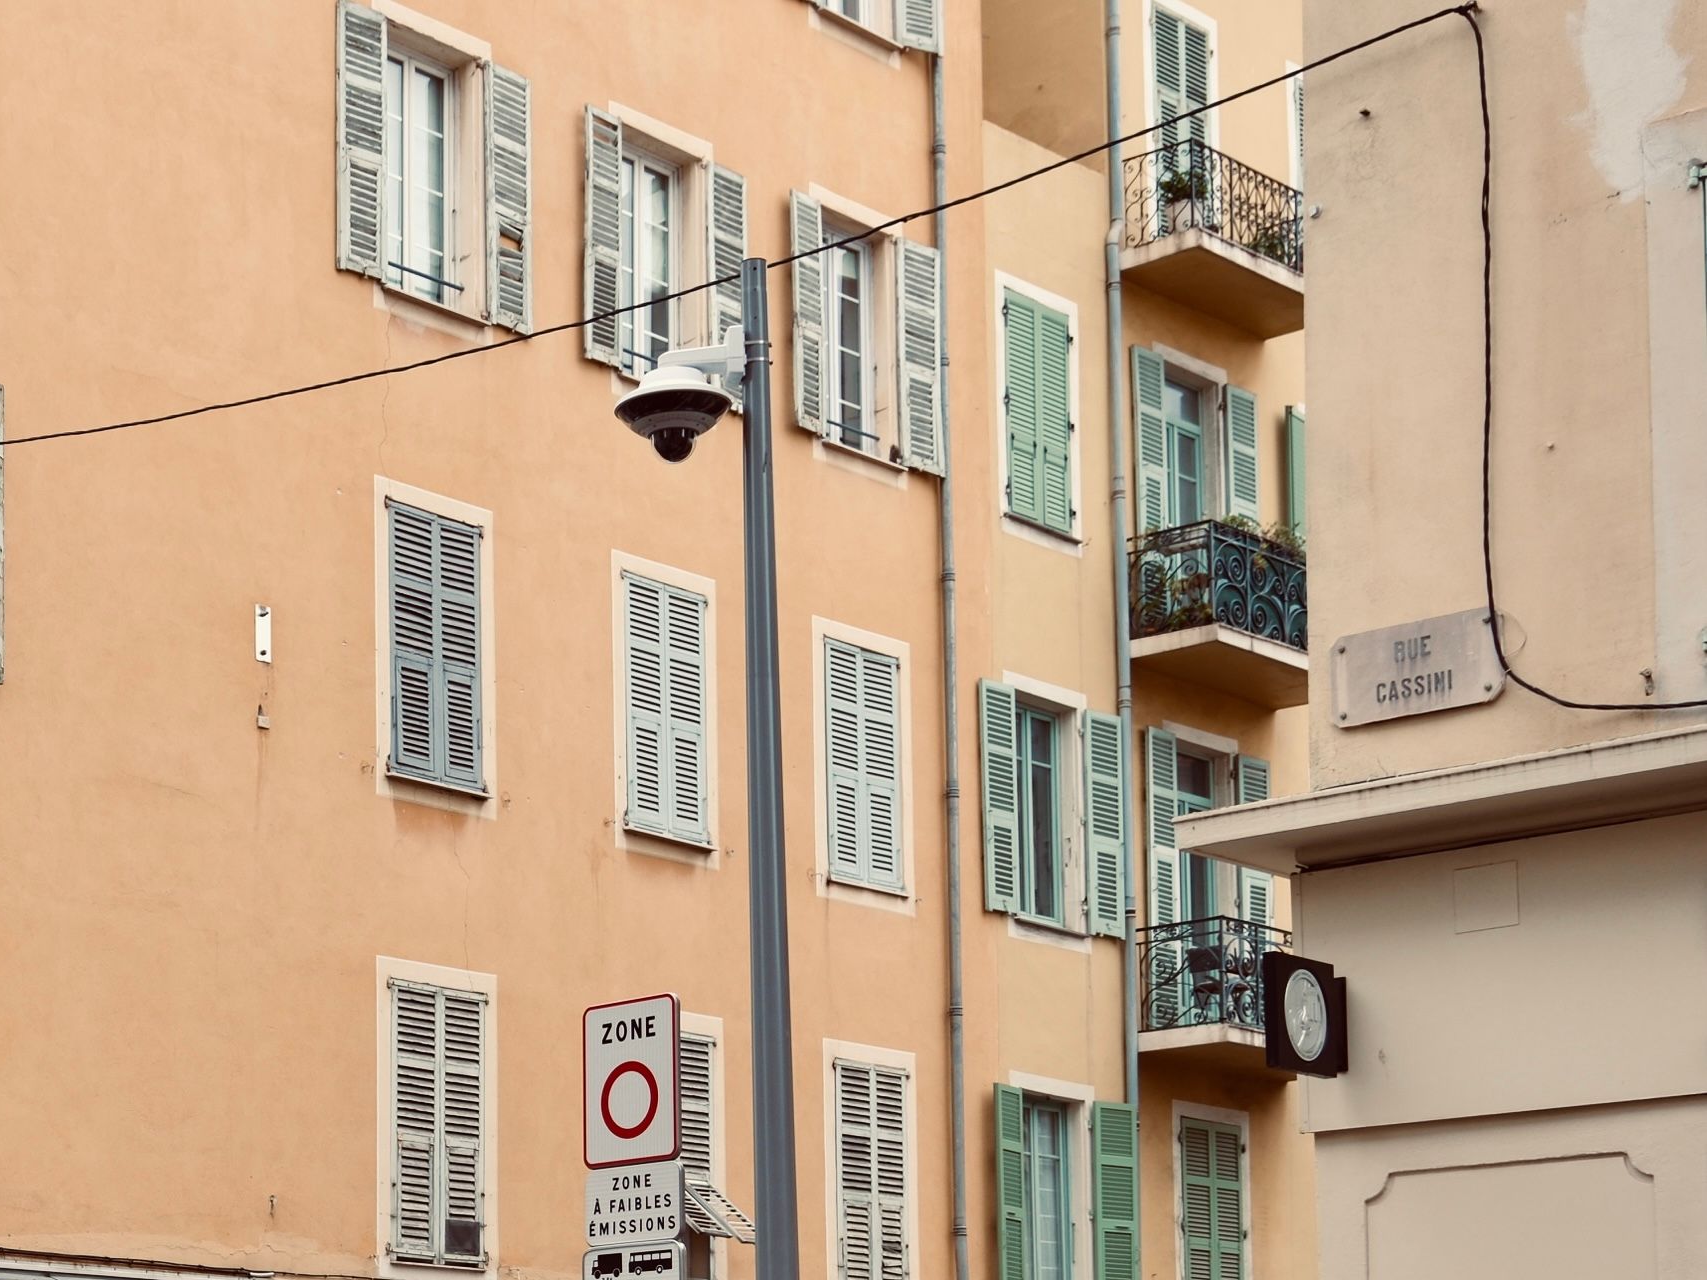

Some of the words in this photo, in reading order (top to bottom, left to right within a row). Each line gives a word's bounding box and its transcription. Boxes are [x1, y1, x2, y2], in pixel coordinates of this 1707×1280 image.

[1394, 635, 1432, 663] RUE
[1376, 669, 1453, 704] CASSINI
[602, 1015, 656, 1045] ZONE
[612, 1174, 652, 1191] ZONE
[594, 1198, 601, 1215] À
[610, 1194, 672, 1213] FAIBLES
[589, 1215, 676, 1237] ÉMISSIONS
